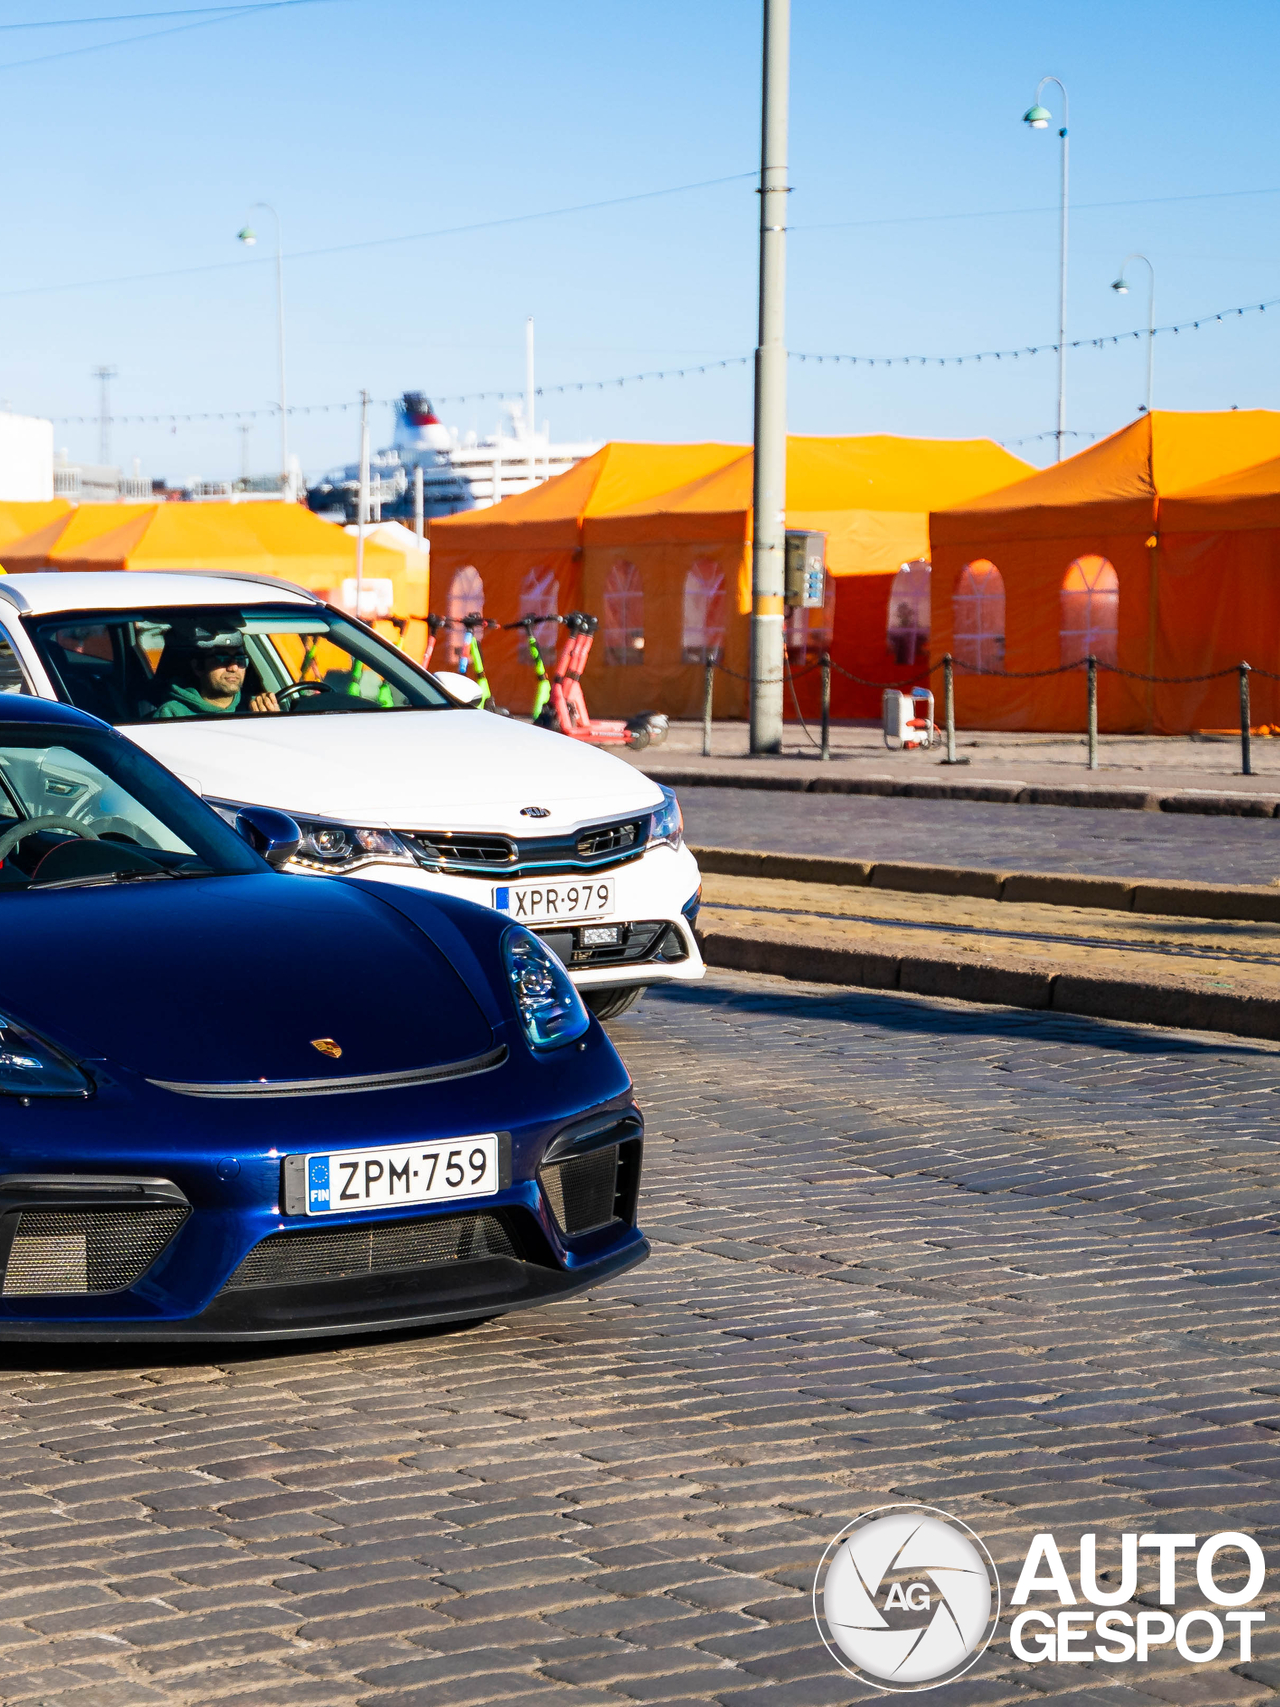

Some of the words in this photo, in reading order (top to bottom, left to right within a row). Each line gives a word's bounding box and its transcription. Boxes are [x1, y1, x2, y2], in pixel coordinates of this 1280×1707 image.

[522, 806, 550, 817] KIA
[515, 884, 609, 916] XPR-979
[339, 1148, 487, 1201] ZPM-759
[310, 1188, 330, 1203] FIN
